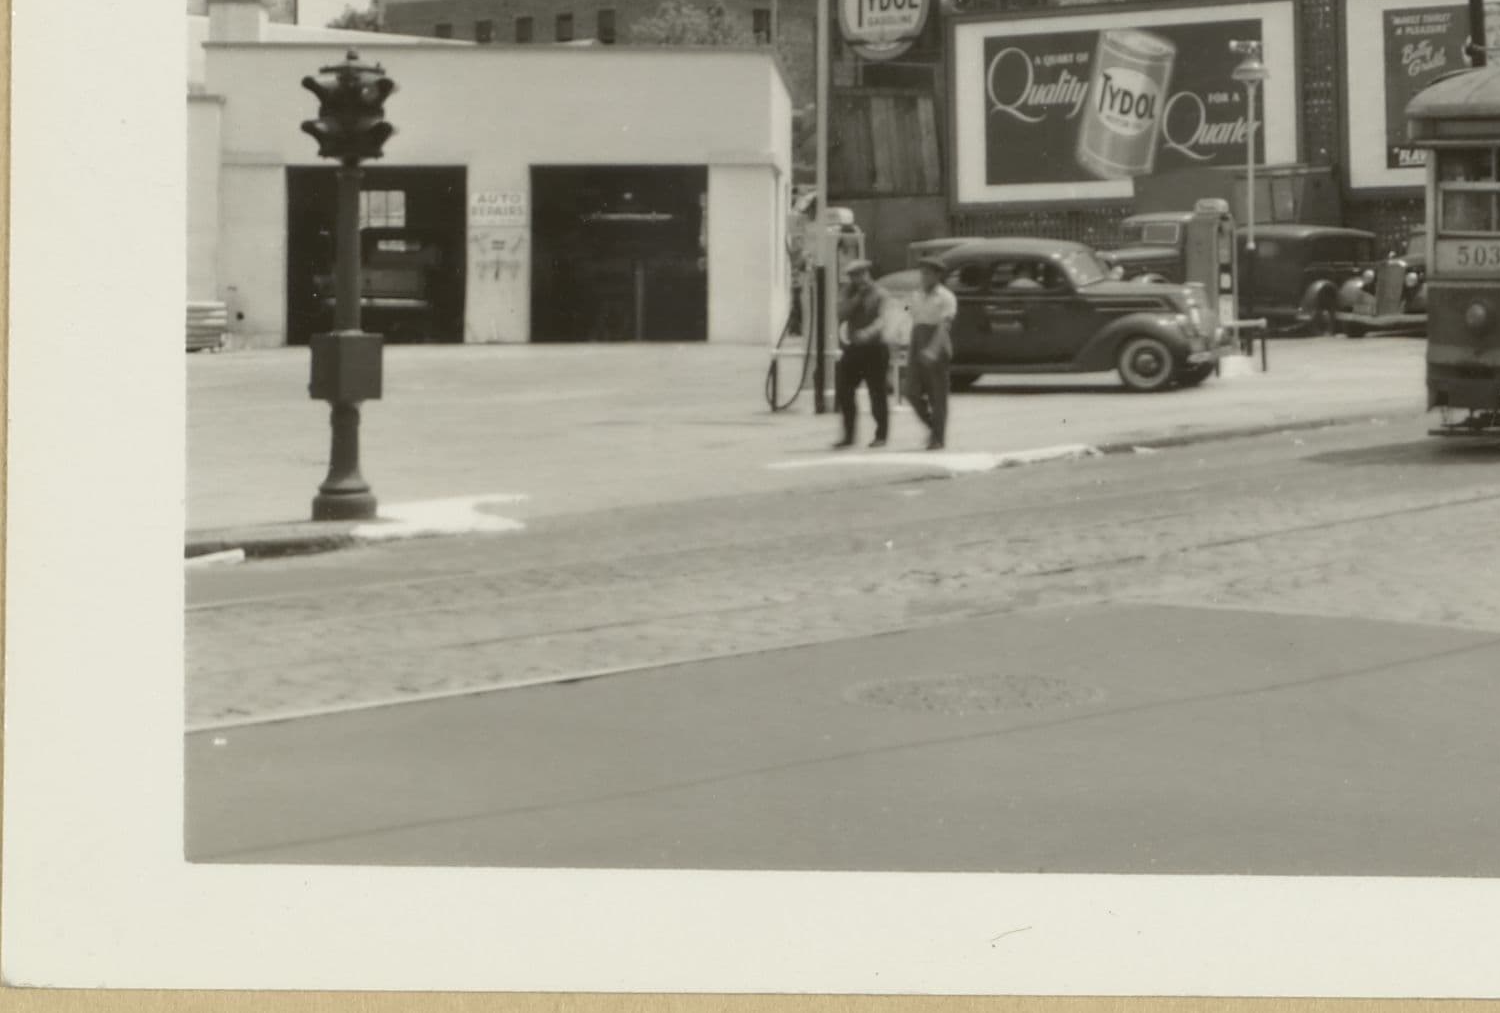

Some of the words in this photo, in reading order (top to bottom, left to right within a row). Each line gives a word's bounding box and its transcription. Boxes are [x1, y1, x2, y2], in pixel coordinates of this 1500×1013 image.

[1034, 54, 1042, 66] A
[1043, 53, 1074, 67] QUART
[987, 47, 1089, 123] Quality
[1099, 72, 1157, 119] TYDOL
[1208, 91, 1228, 104] FOR
[1231, 91, 1240, 103] A
[1163, 91, 1261, 161] Quarter
[476, 194, 521, 204] AUTO
[471, 205, 524, 216] REPAIRS
